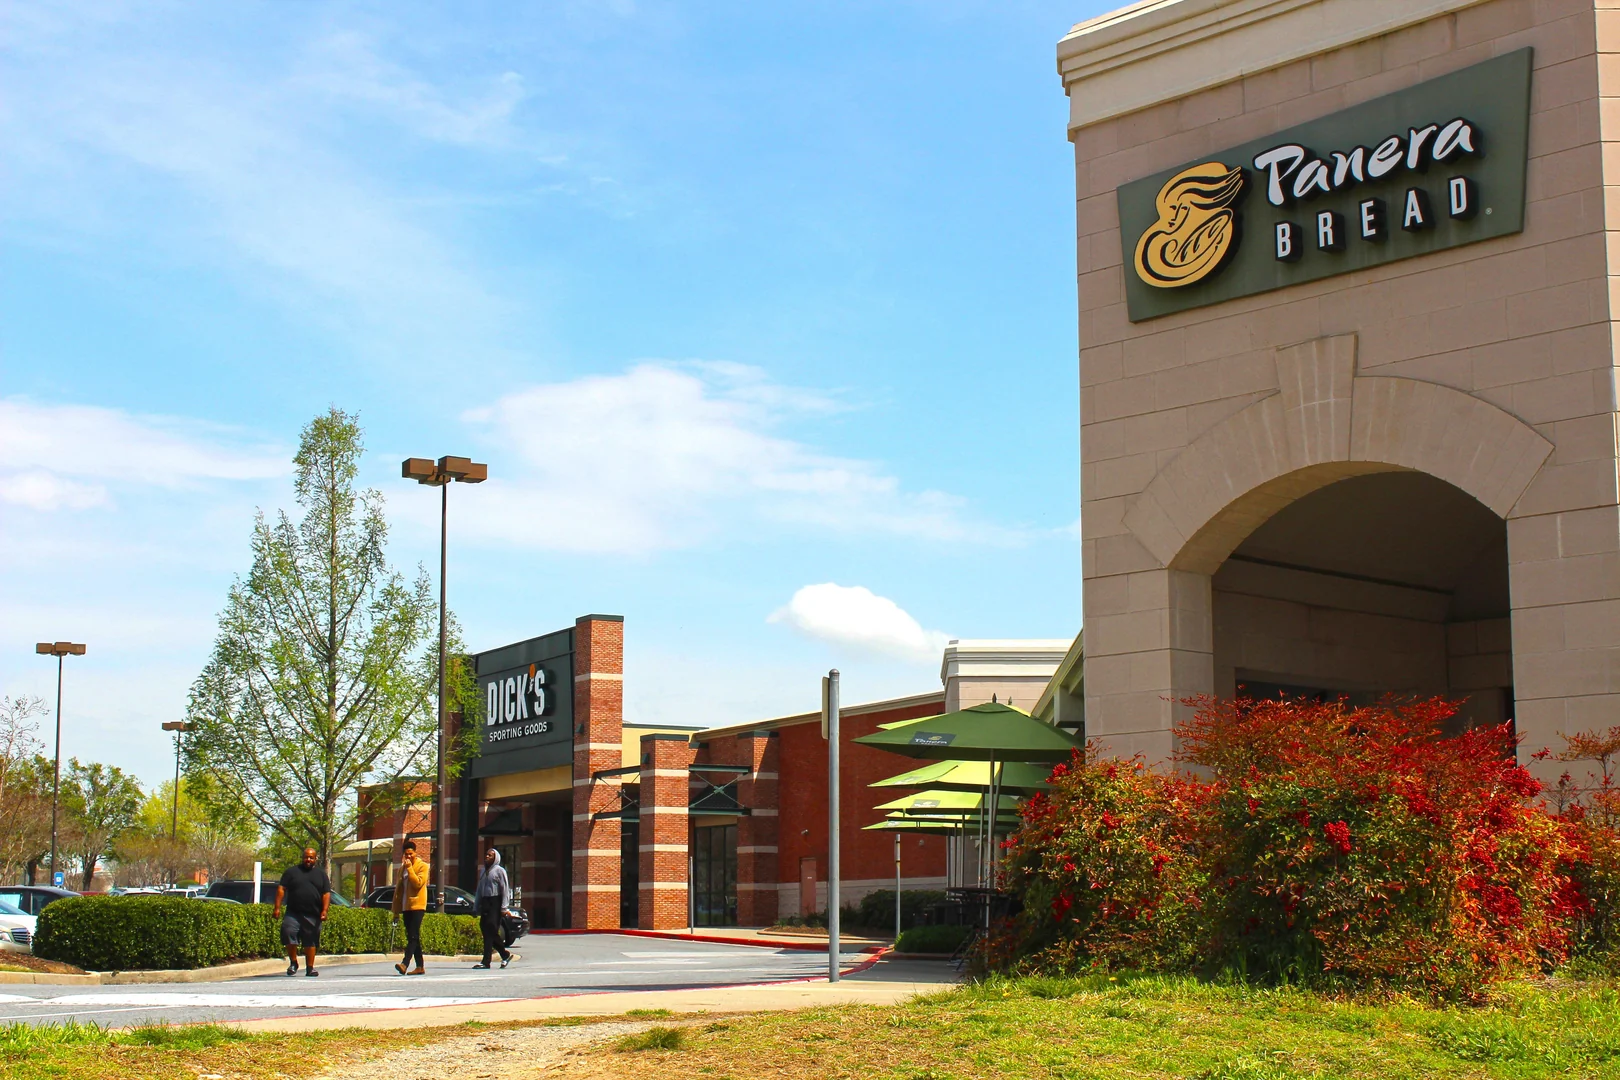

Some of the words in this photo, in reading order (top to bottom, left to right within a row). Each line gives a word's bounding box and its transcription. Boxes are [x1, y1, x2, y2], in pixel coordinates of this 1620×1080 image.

[1254, 118, 1475, 206] Panera
[1275, 176, 1468, 259] BREAD
[487, 663, 545, 726] DICK'S
[489, 726, 522, 742] SPORTING
[524, 721, 548, 735] GOODS
